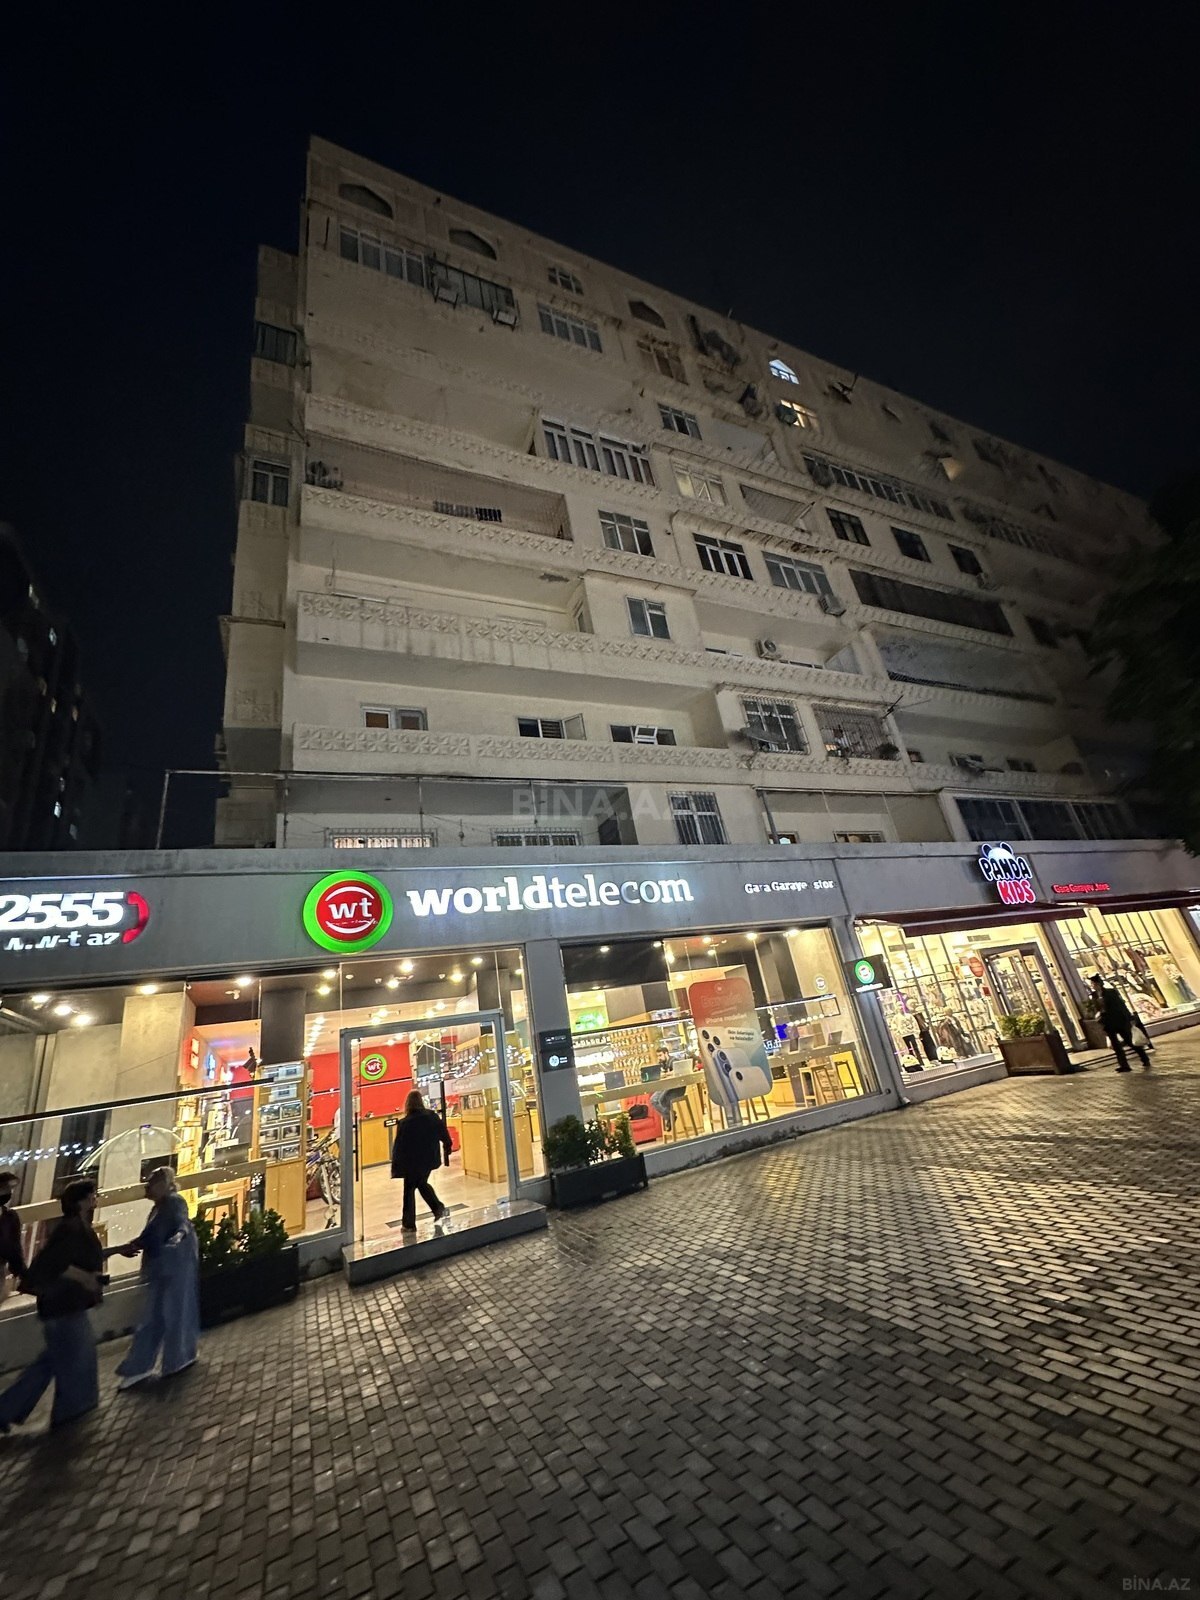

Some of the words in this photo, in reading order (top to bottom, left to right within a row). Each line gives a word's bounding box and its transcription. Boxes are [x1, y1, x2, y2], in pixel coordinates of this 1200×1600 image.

[979, 857, 1032, 881] PANDA
[407, 874, 694, 916] worldtelecom
[813, 880, 837, 889] stor
[997, 880, 1035, 904] KIDS
[0, 892, 124, 930] 2555
[328, 897, 372, 919] wt
